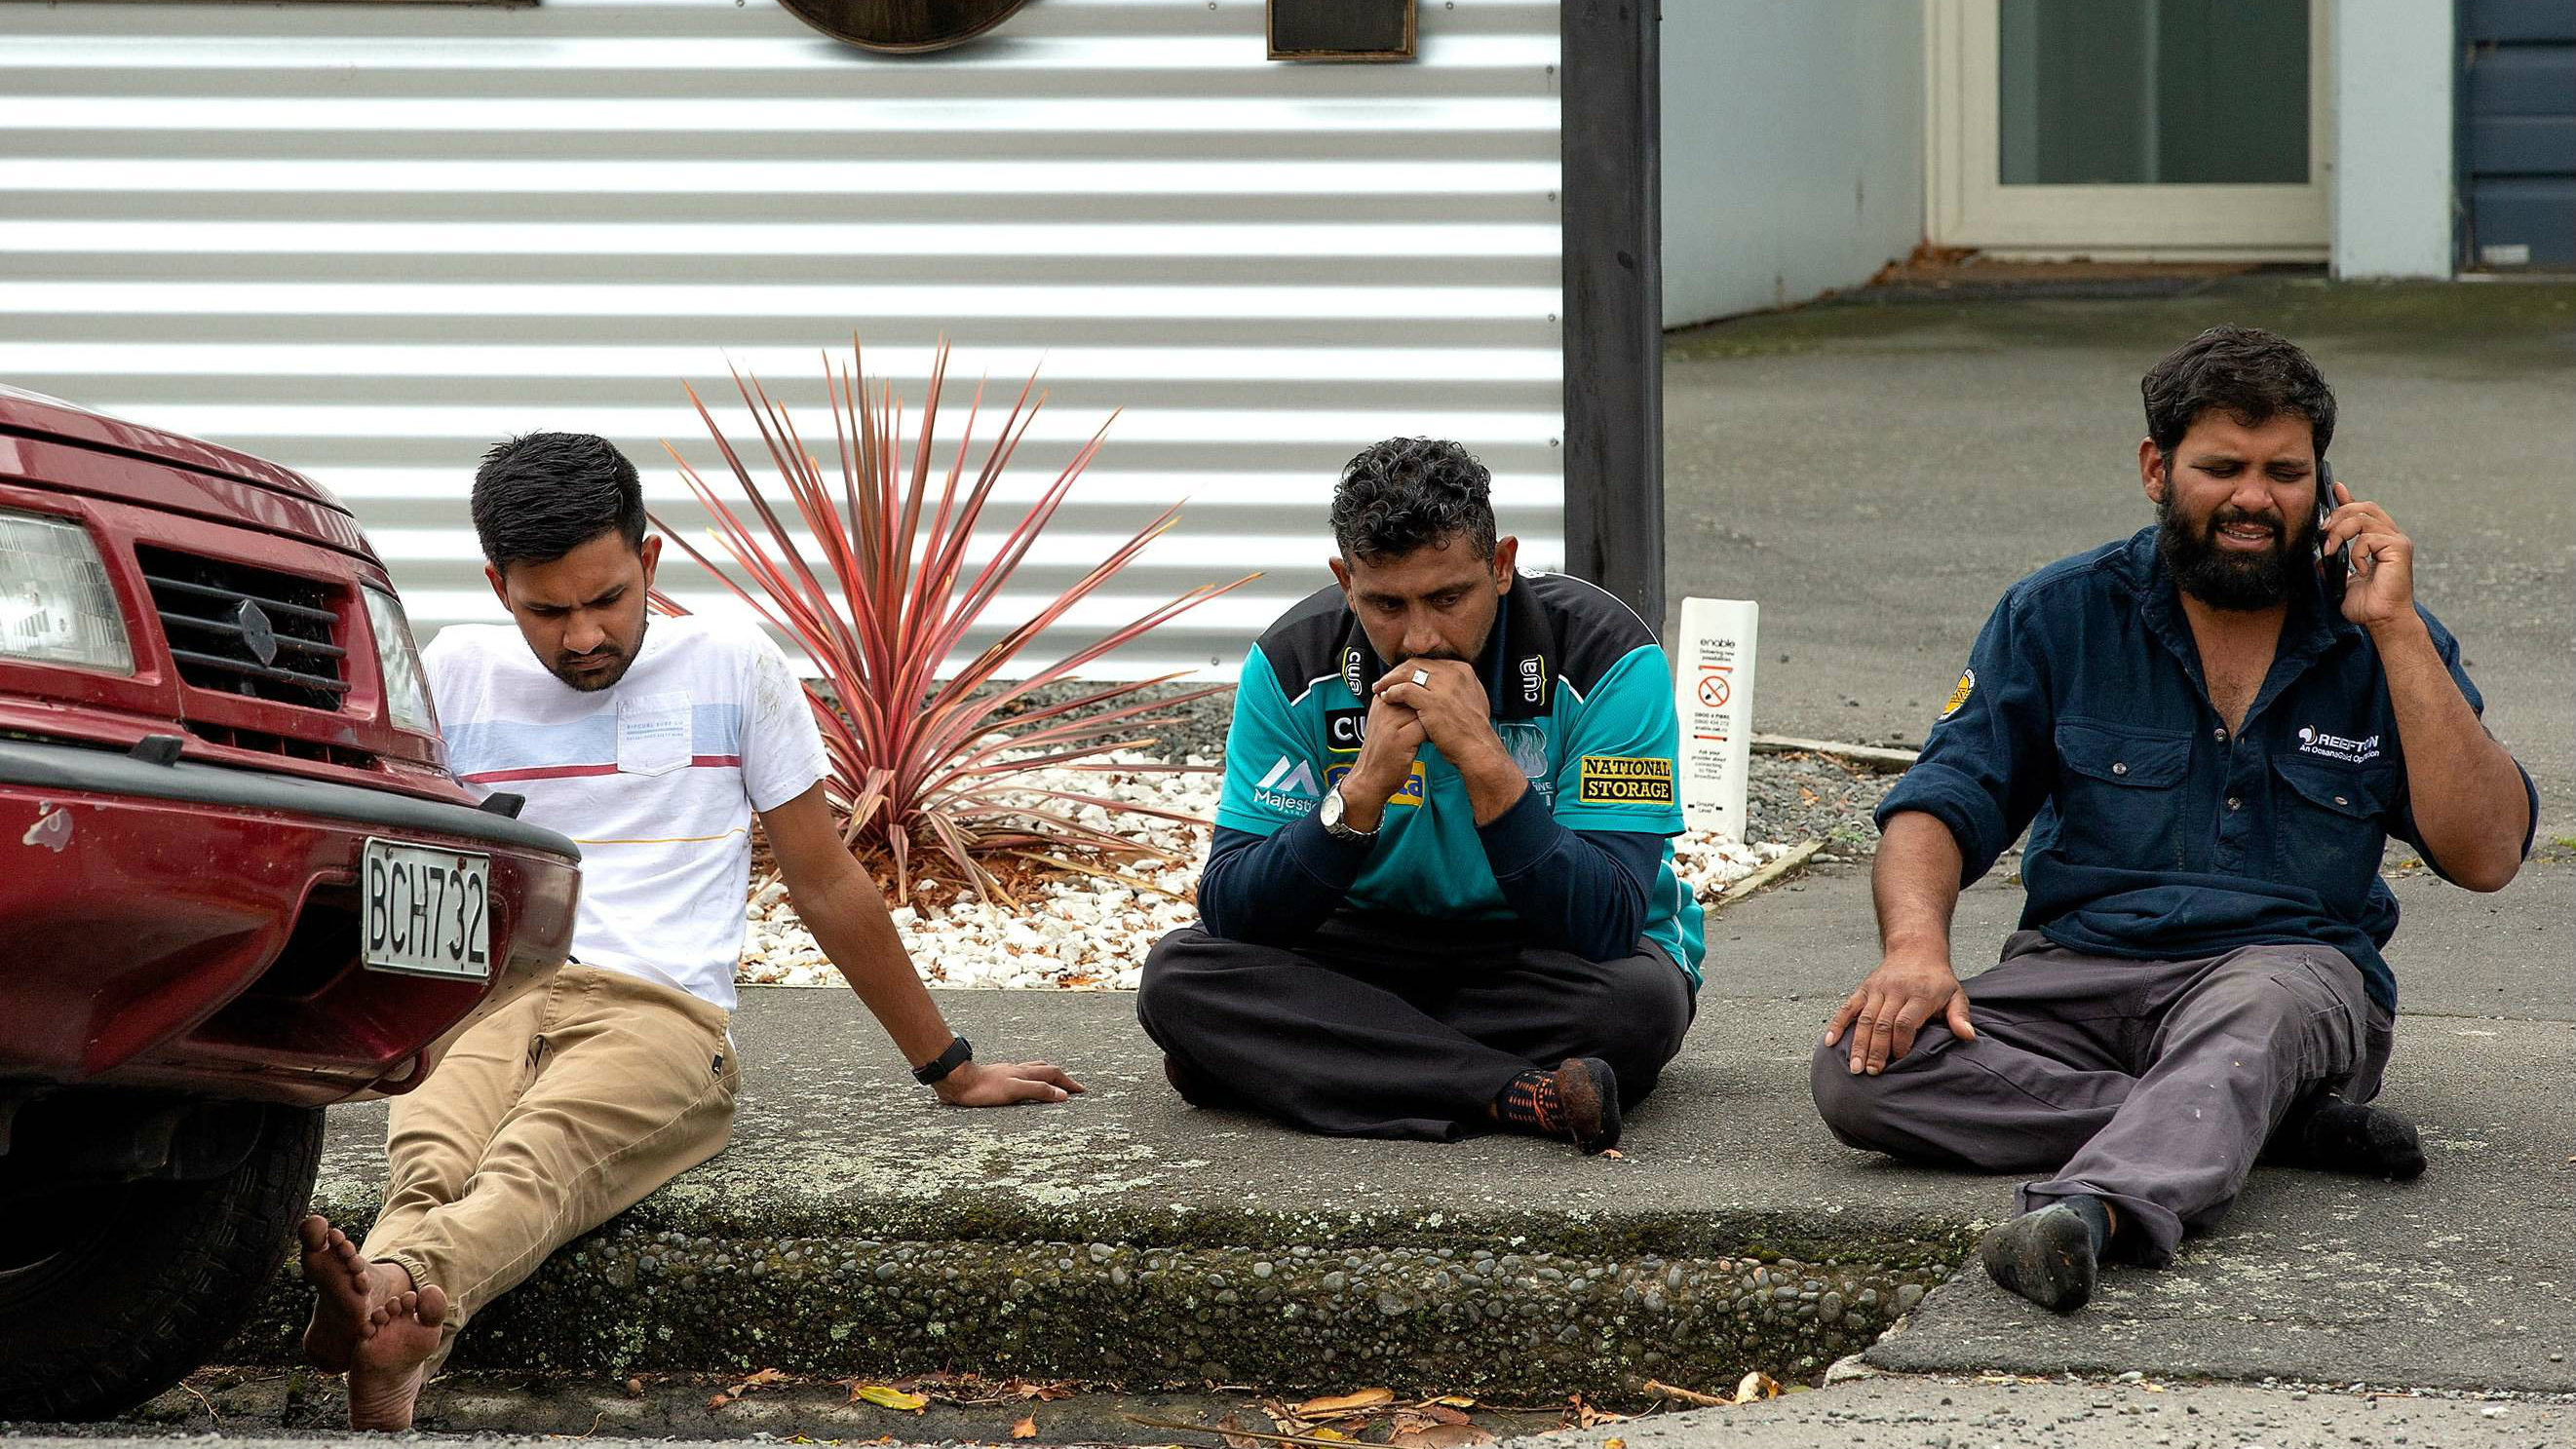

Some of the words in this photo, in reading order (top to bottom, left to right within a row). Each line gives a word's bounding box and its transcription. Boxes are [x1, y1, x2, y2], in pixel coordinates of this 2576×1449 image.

[1700, 638, 1736, 648] enable
[1519, 656, 1541, 703] cua
[2299, 744, 2311, 752] An
[2318, 734, 2379, 752] REEFTON
[1585, 758, 1671, 777] NATIONAL
[1588, 781, 1670, 798] STORAGE
[370, 858, 485, 964] BCH732
